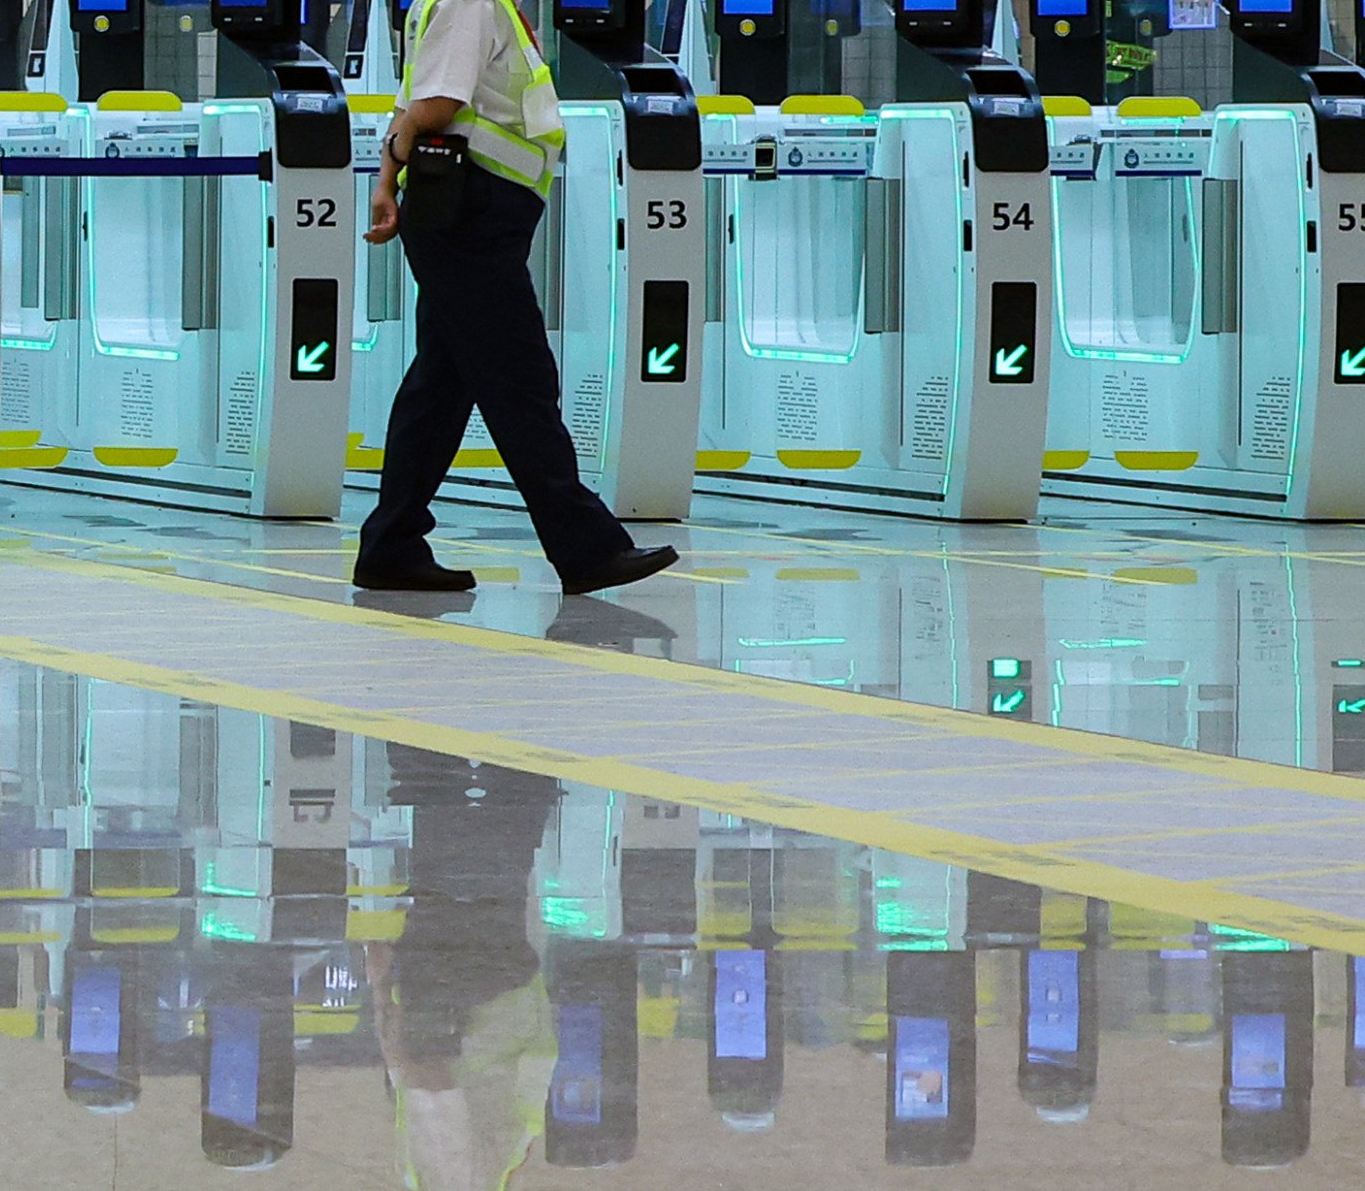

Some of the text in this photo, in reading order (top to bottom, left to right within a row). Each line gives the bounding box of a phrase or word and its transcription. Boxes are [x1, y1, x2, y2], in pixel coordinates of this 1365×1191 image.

[296, 198, 337, 228] 52
[647, 200, 688, 230] 53
[992, 202, 1035, 231] 54
[1338, 203, 1365, 232] 5
